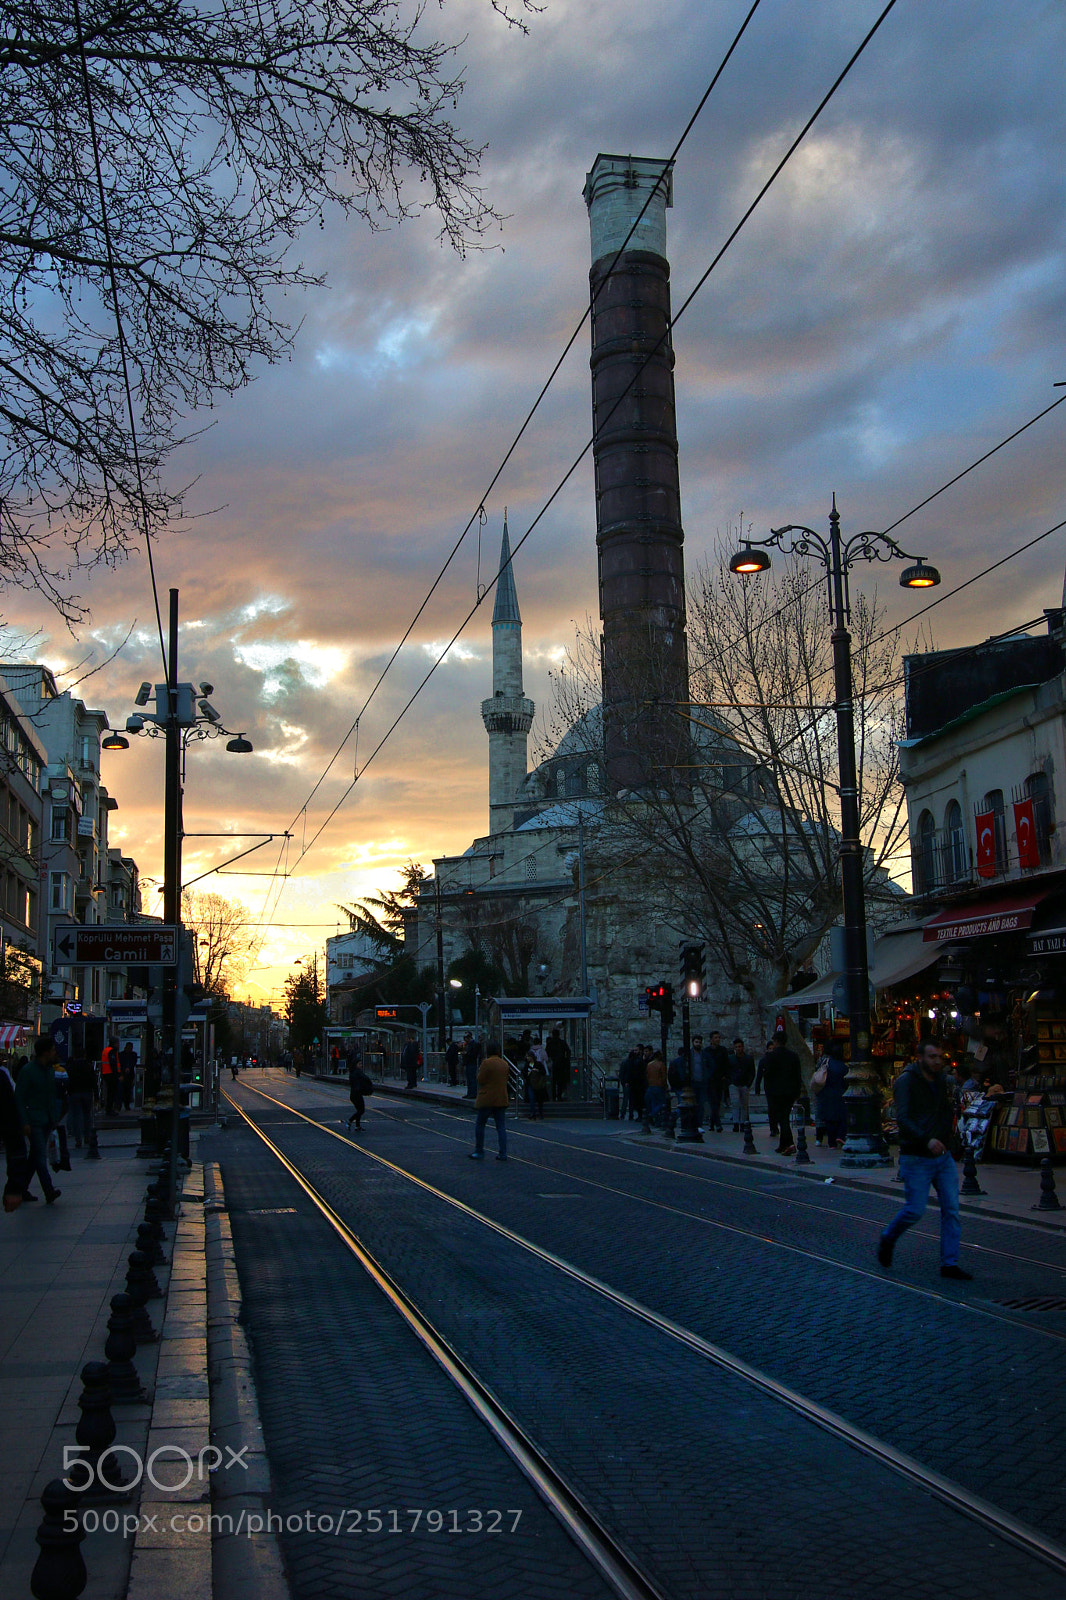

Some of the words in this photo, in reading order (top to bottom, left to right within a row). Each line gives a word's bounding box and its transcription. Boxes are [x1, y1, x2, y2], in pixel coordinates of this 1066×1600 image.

[937, 927, 959, 940] TEXTILE
[958, 922, 988, 937] PRODUCTS
[987, 919, 1001, 932] AND
[1001, 917, 1019, 929] BAGS
[78, 932, 112, 945] Köprülü
[115, 932, 151, 943] Mehmet
[104, 947, 147, 960] Camii
